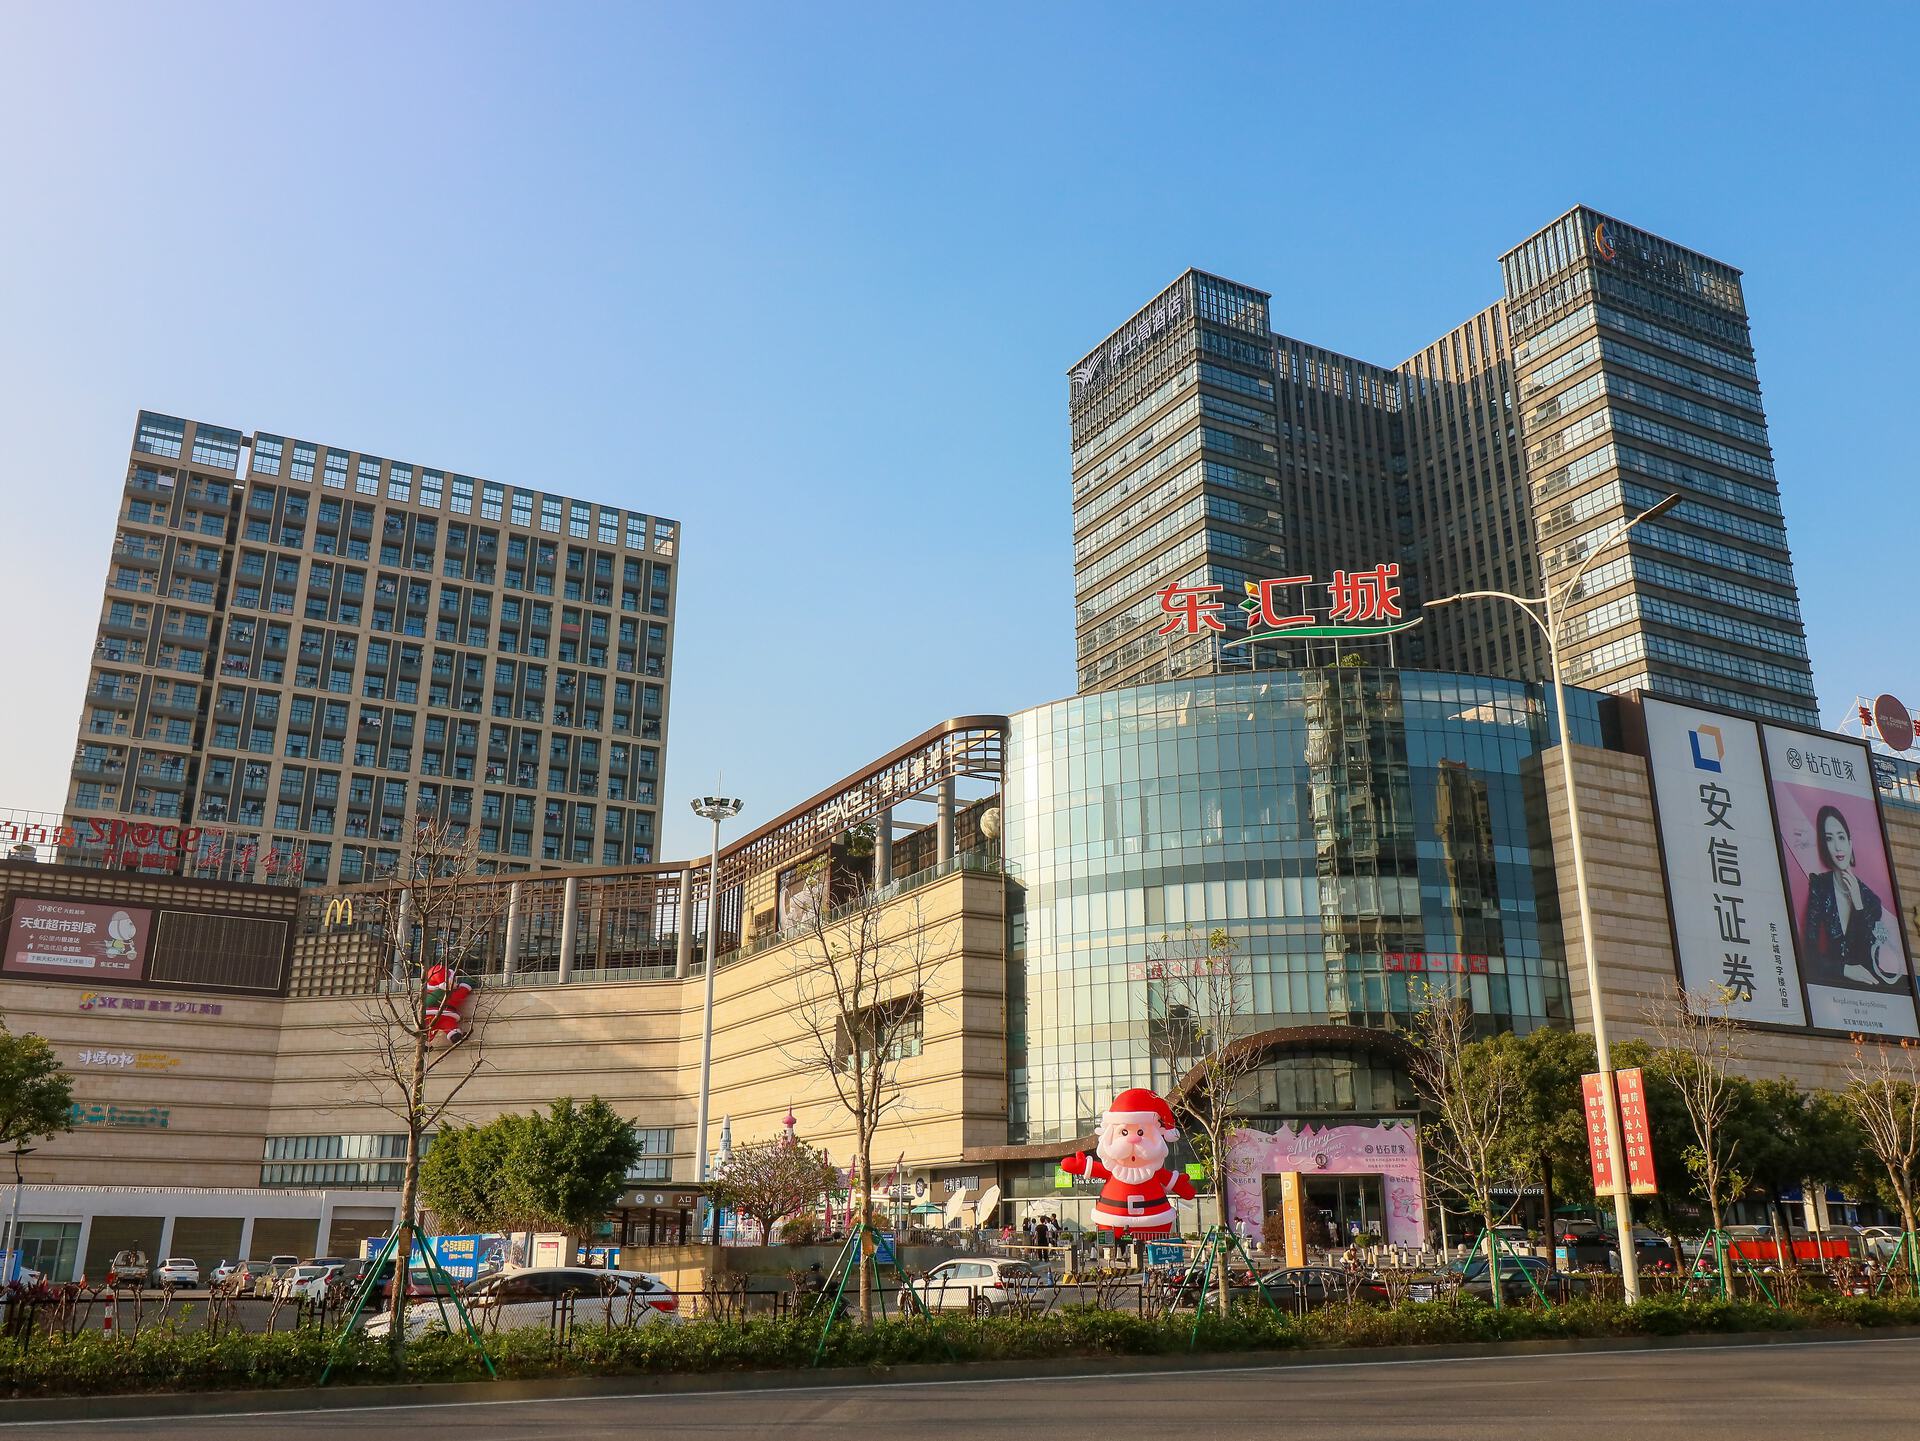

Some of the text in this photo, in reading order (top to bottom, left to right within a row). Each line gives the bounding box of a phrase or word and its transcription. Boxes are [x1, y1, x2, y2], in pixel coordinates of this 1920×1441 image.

[1156, 562, 1402, 635] 东汇城
[1805, 751, 1857, 782] 钻石世家
[816, 747, 942, 832] SPACE 空间餐吧
[200, 842, 306, 875] 新华书店
[1699, 782, 1757, 1002] 安信证券
[20, 916, 97, 934] 天虹超市到家
[1375, 1144, 1406, 1155] 钻石世家
[678, 1195, 692, 1204] 入口
[1283, 1180, 1292, 1197] P
[1480, 1187, 1522, 1195] SARBUCKS
